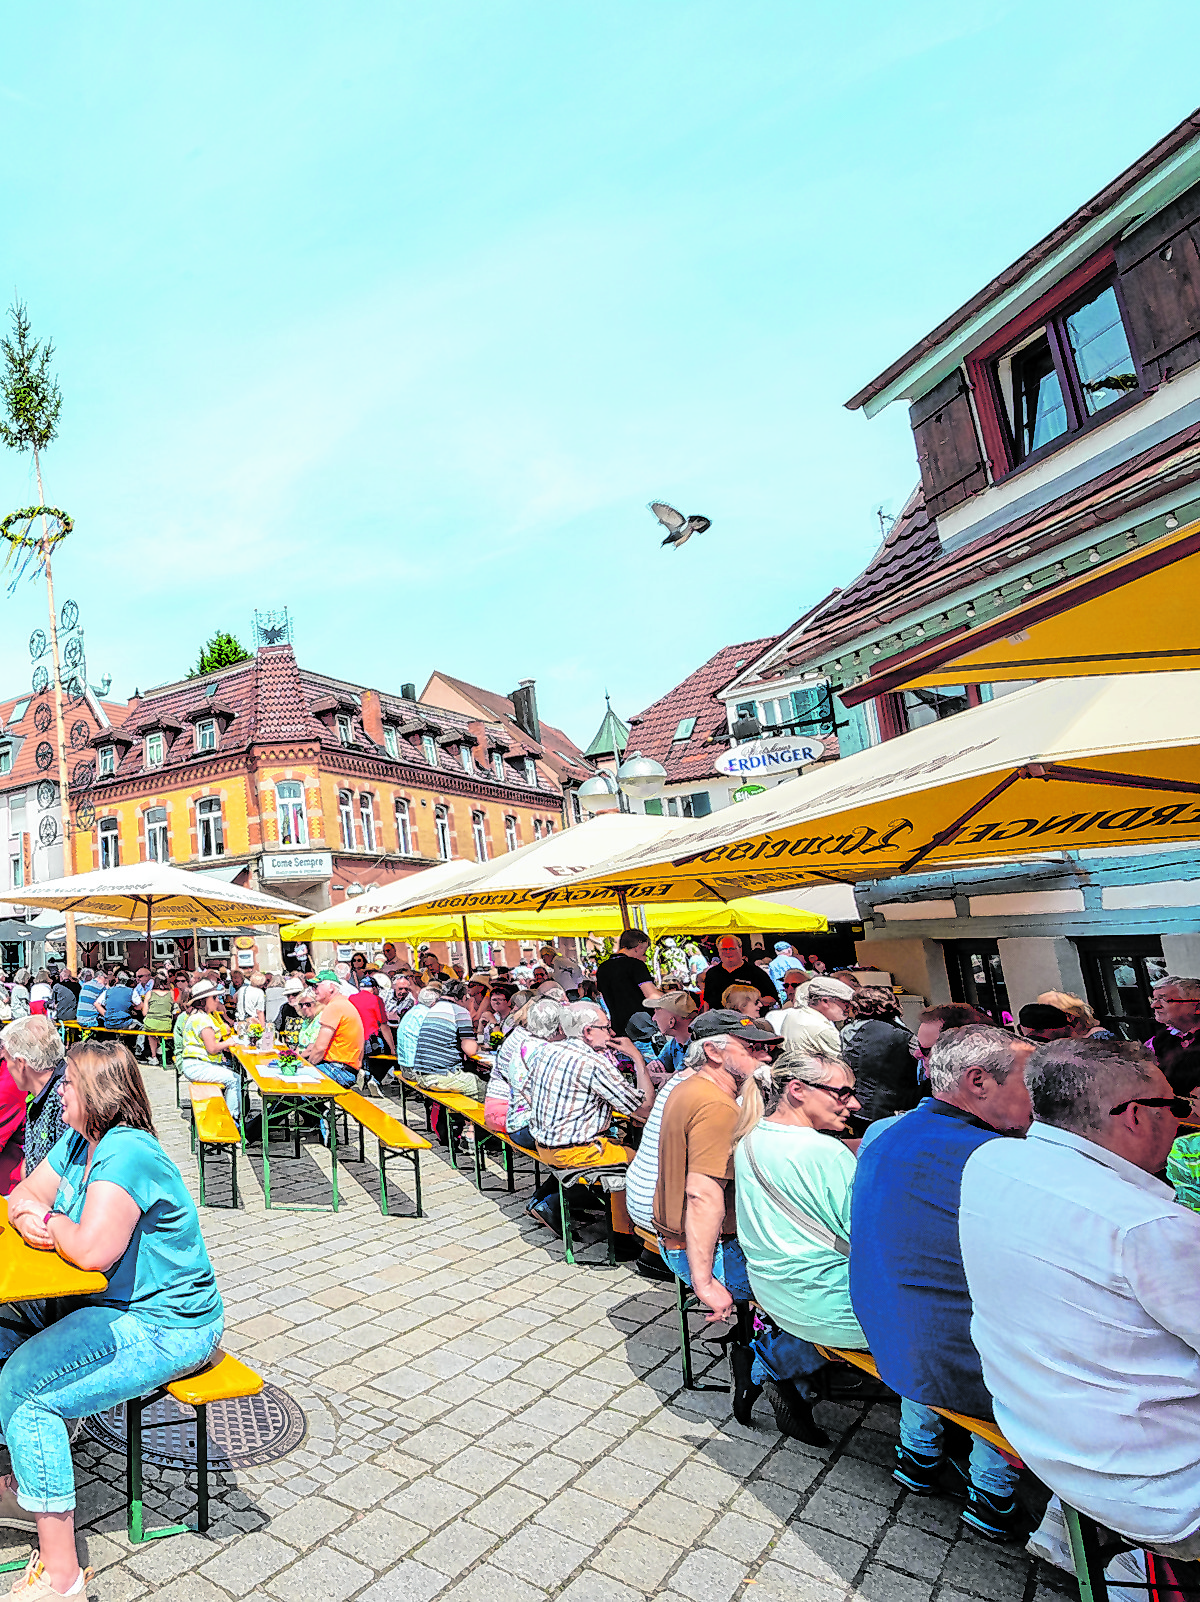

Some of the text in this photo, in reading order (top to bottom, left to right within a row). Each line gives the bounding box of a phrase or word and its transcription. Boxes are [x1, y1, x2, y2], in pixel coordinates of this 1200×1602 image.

[728, 747, 817, 772] ERDINGER
[271, 857, 324, 868] Come Sempre
